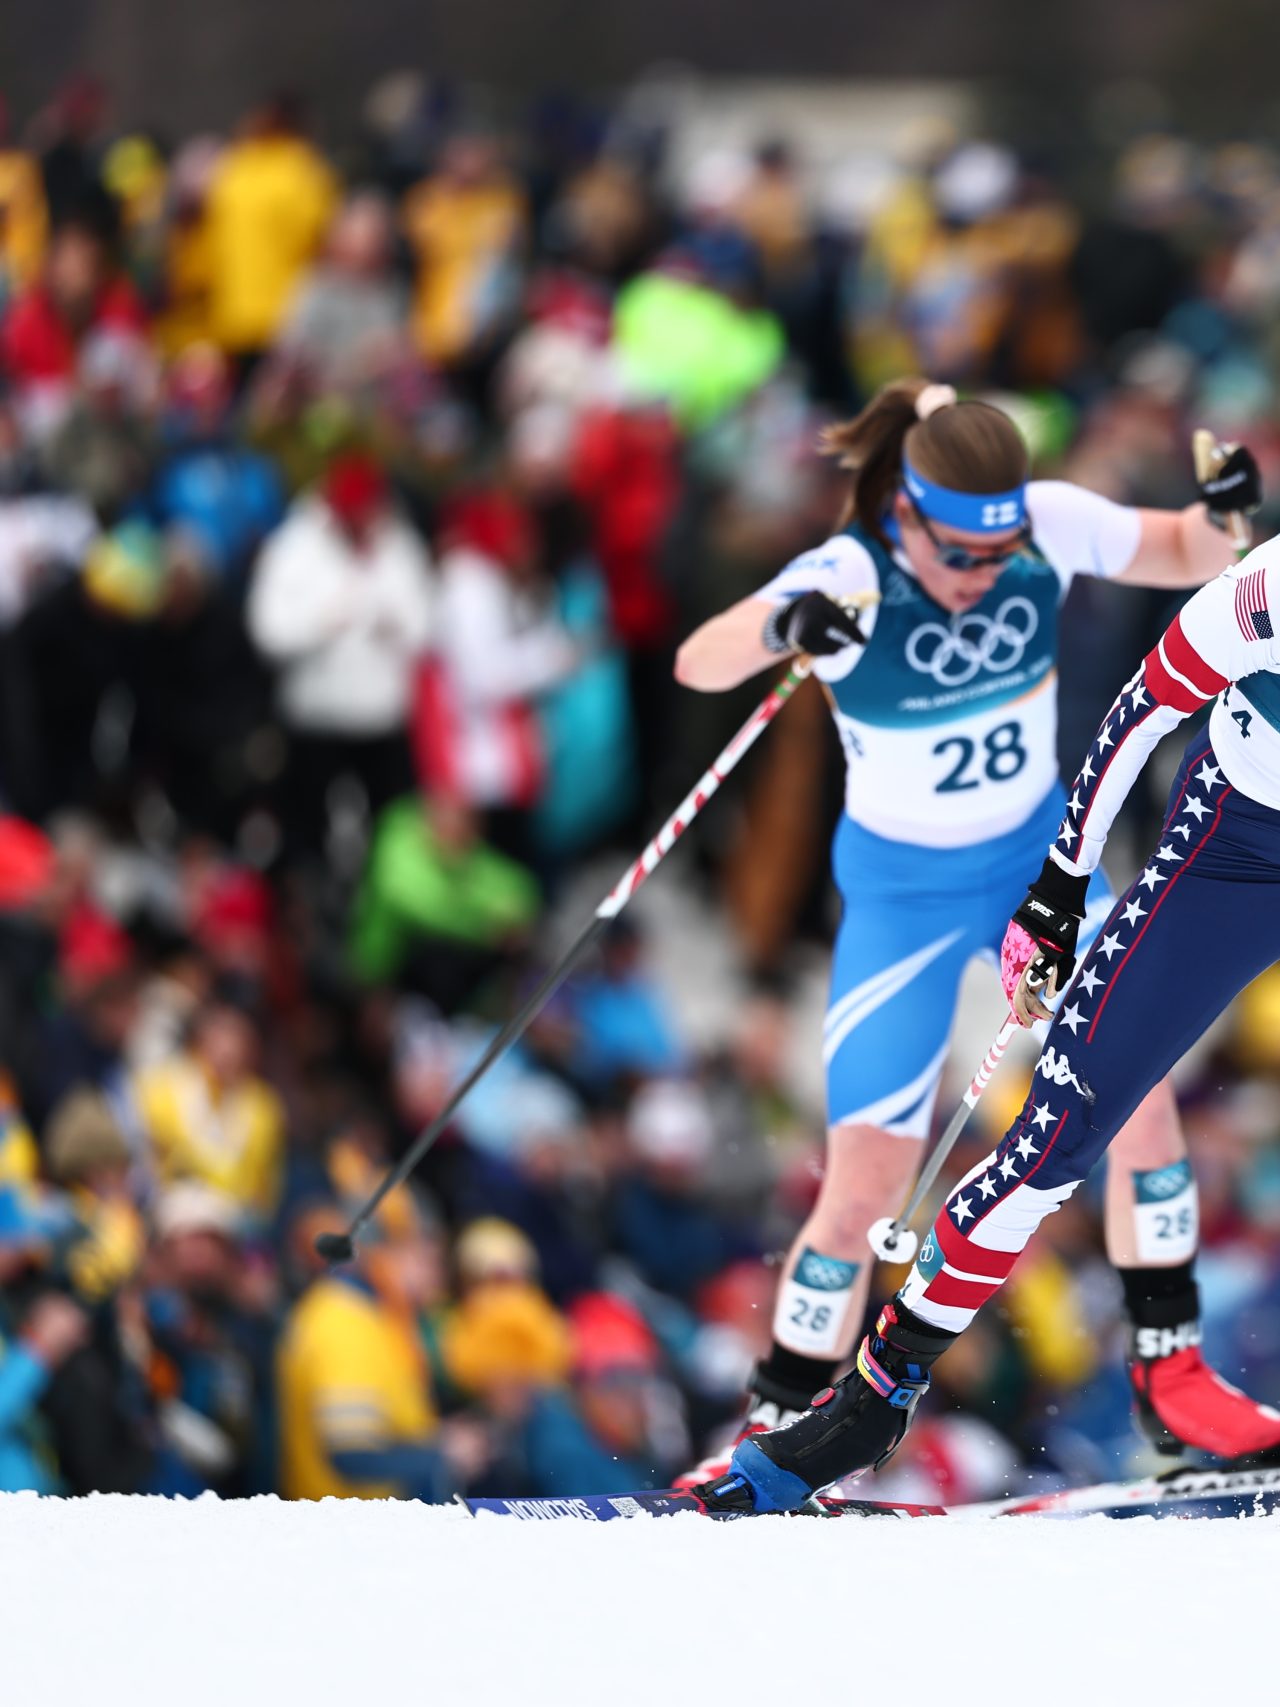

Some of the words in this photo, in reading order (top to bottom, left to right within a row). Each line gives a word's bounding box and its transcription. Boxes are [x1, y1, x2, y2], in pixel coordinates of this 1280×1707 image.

[932, 721, 1027, 794] 28
[789, 1298, 832, 1332] 28
[502, 1499, 598, 1522] SALOMON
